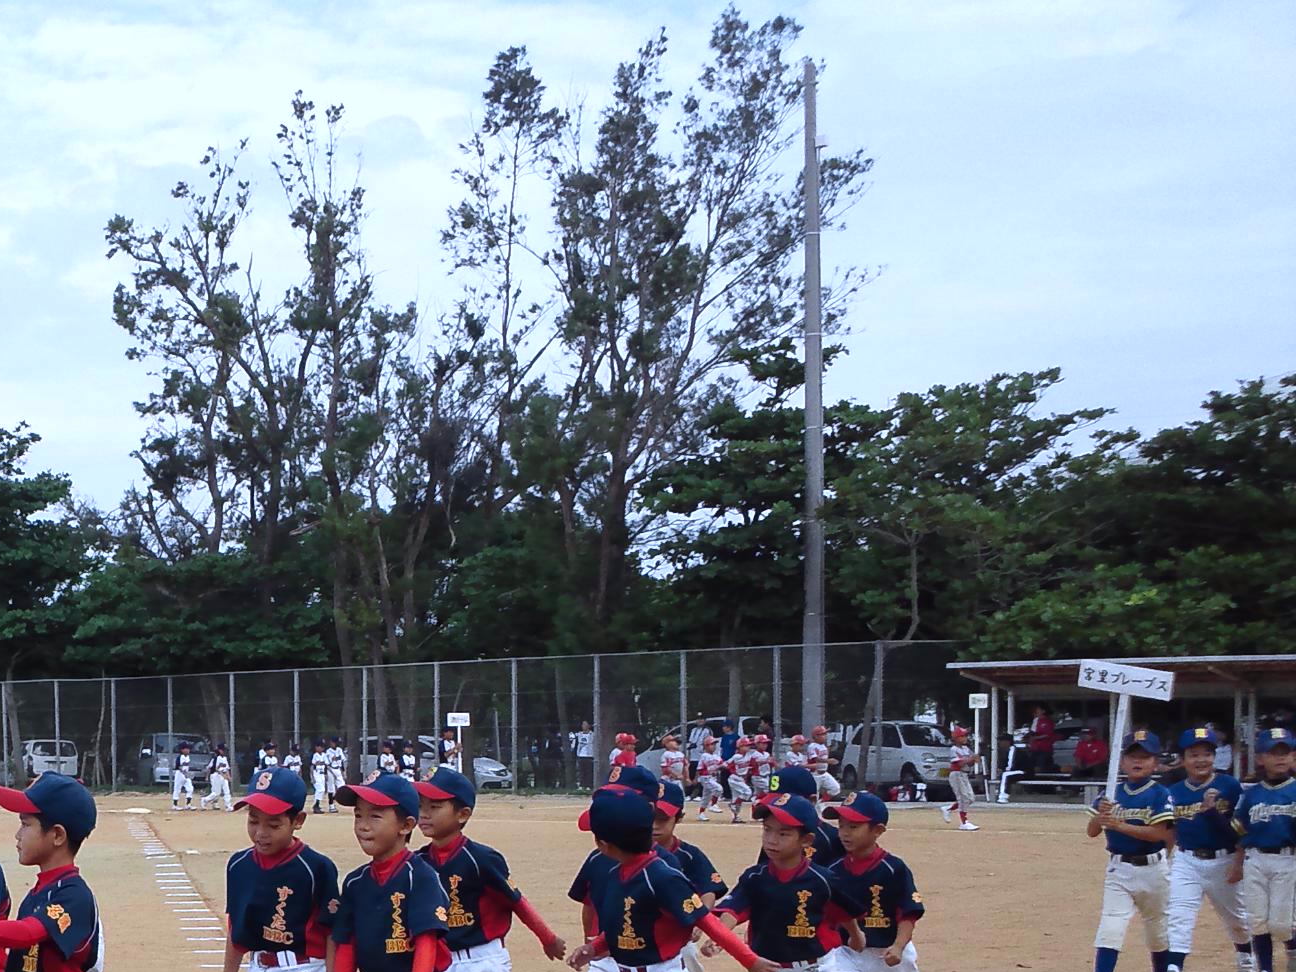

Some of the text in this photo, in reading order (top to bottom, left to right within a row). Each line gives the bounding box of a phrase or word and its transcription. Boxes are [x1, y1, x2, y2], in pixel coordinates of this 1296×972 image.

[256, 772, 273, 790] S
[270, 885, 294, 931] すくた
[390, 891, 406, 939] すくた
[448, 874, 465, 915] すくた
[262, 924, 294, 945] BBC
